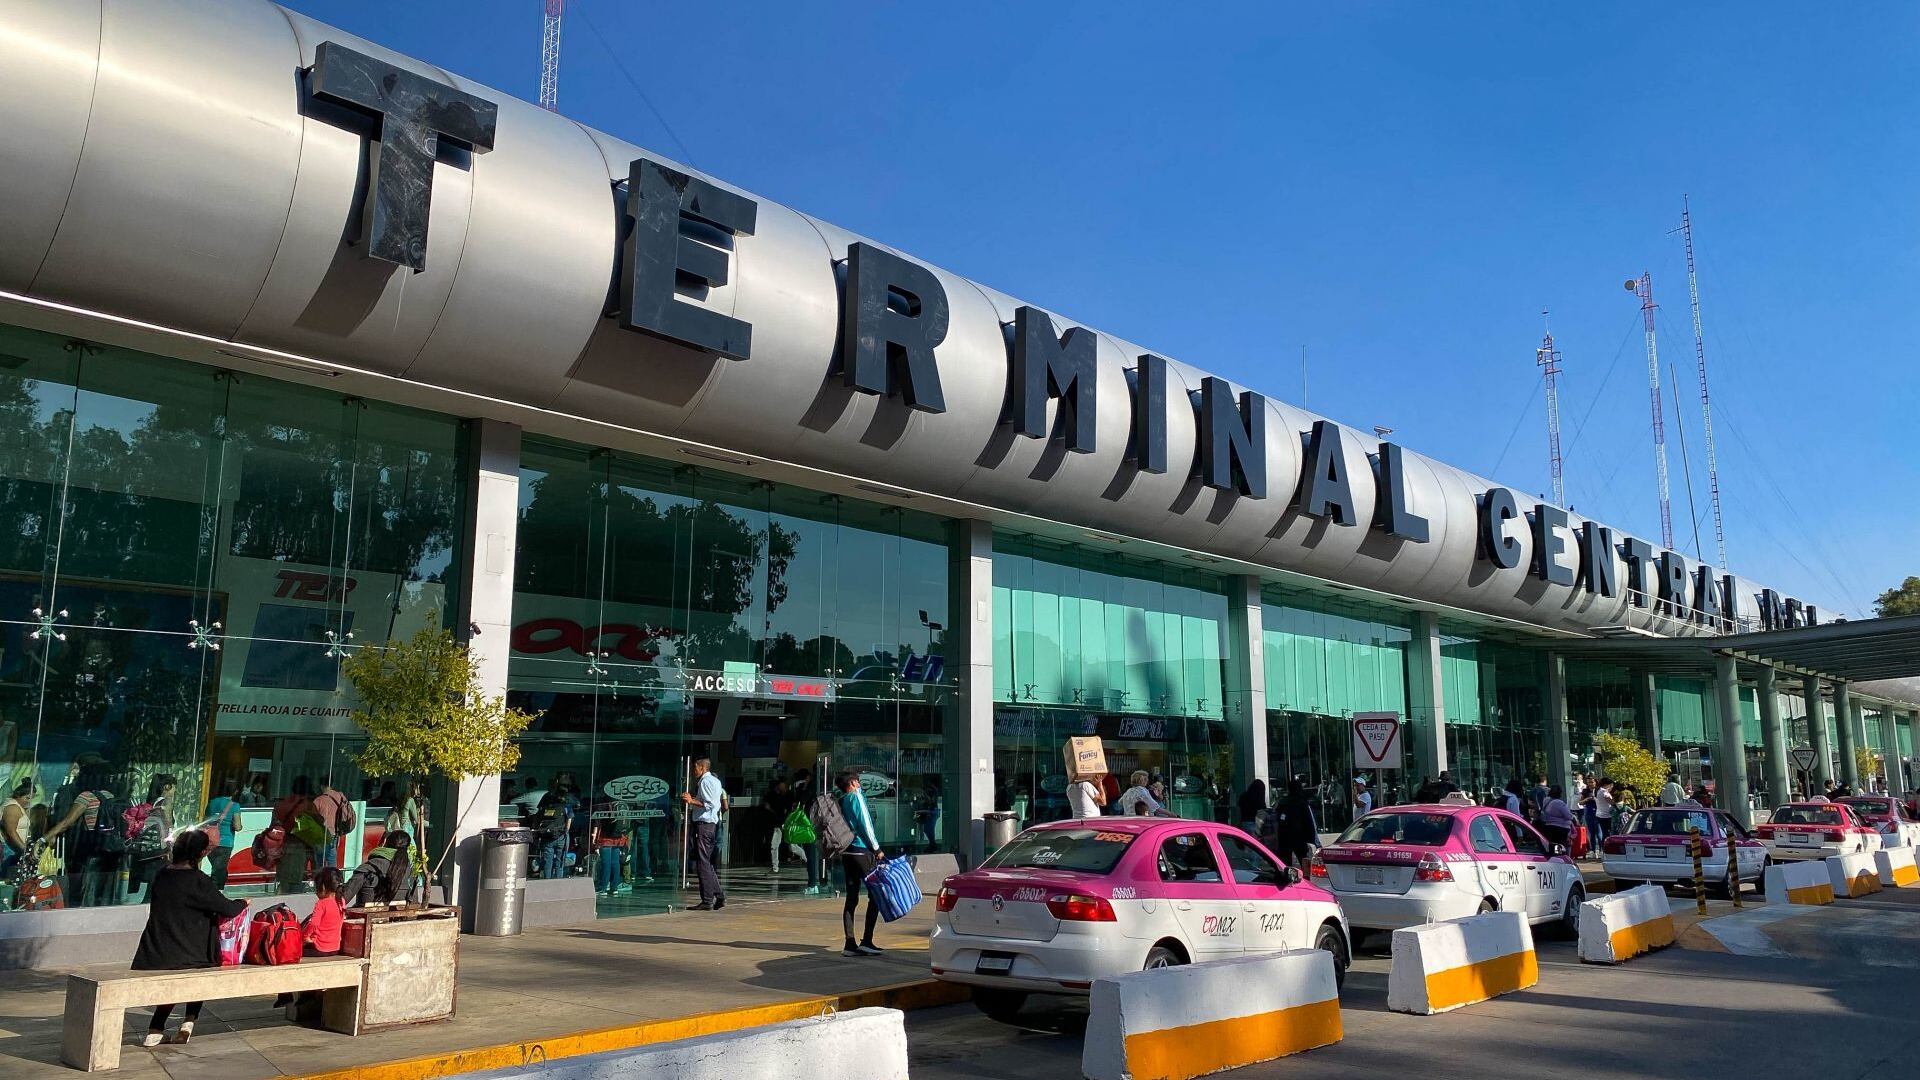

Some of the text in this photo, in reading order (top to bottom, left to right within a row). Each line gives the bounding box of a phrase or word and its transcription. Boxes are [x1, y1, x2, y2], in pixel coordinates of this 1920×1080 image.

[311, 40, 1430, 544] TERMINAL
[694, 675, 756, 692] ACCESO
[260, 704, 290, 715] ROJA
[292, 706, 307, 716] DE
[1362, 723, 1388, 731] CEDA EL
[1368, 732, 1385, 741] PASO
[1499, 870, 1520, 885] CDMX
[1537, 871, 1556, 889] TAXI
[1202, 915, 1237, 933] CDMX
[1260, 913, 1285, 933] TAXI
